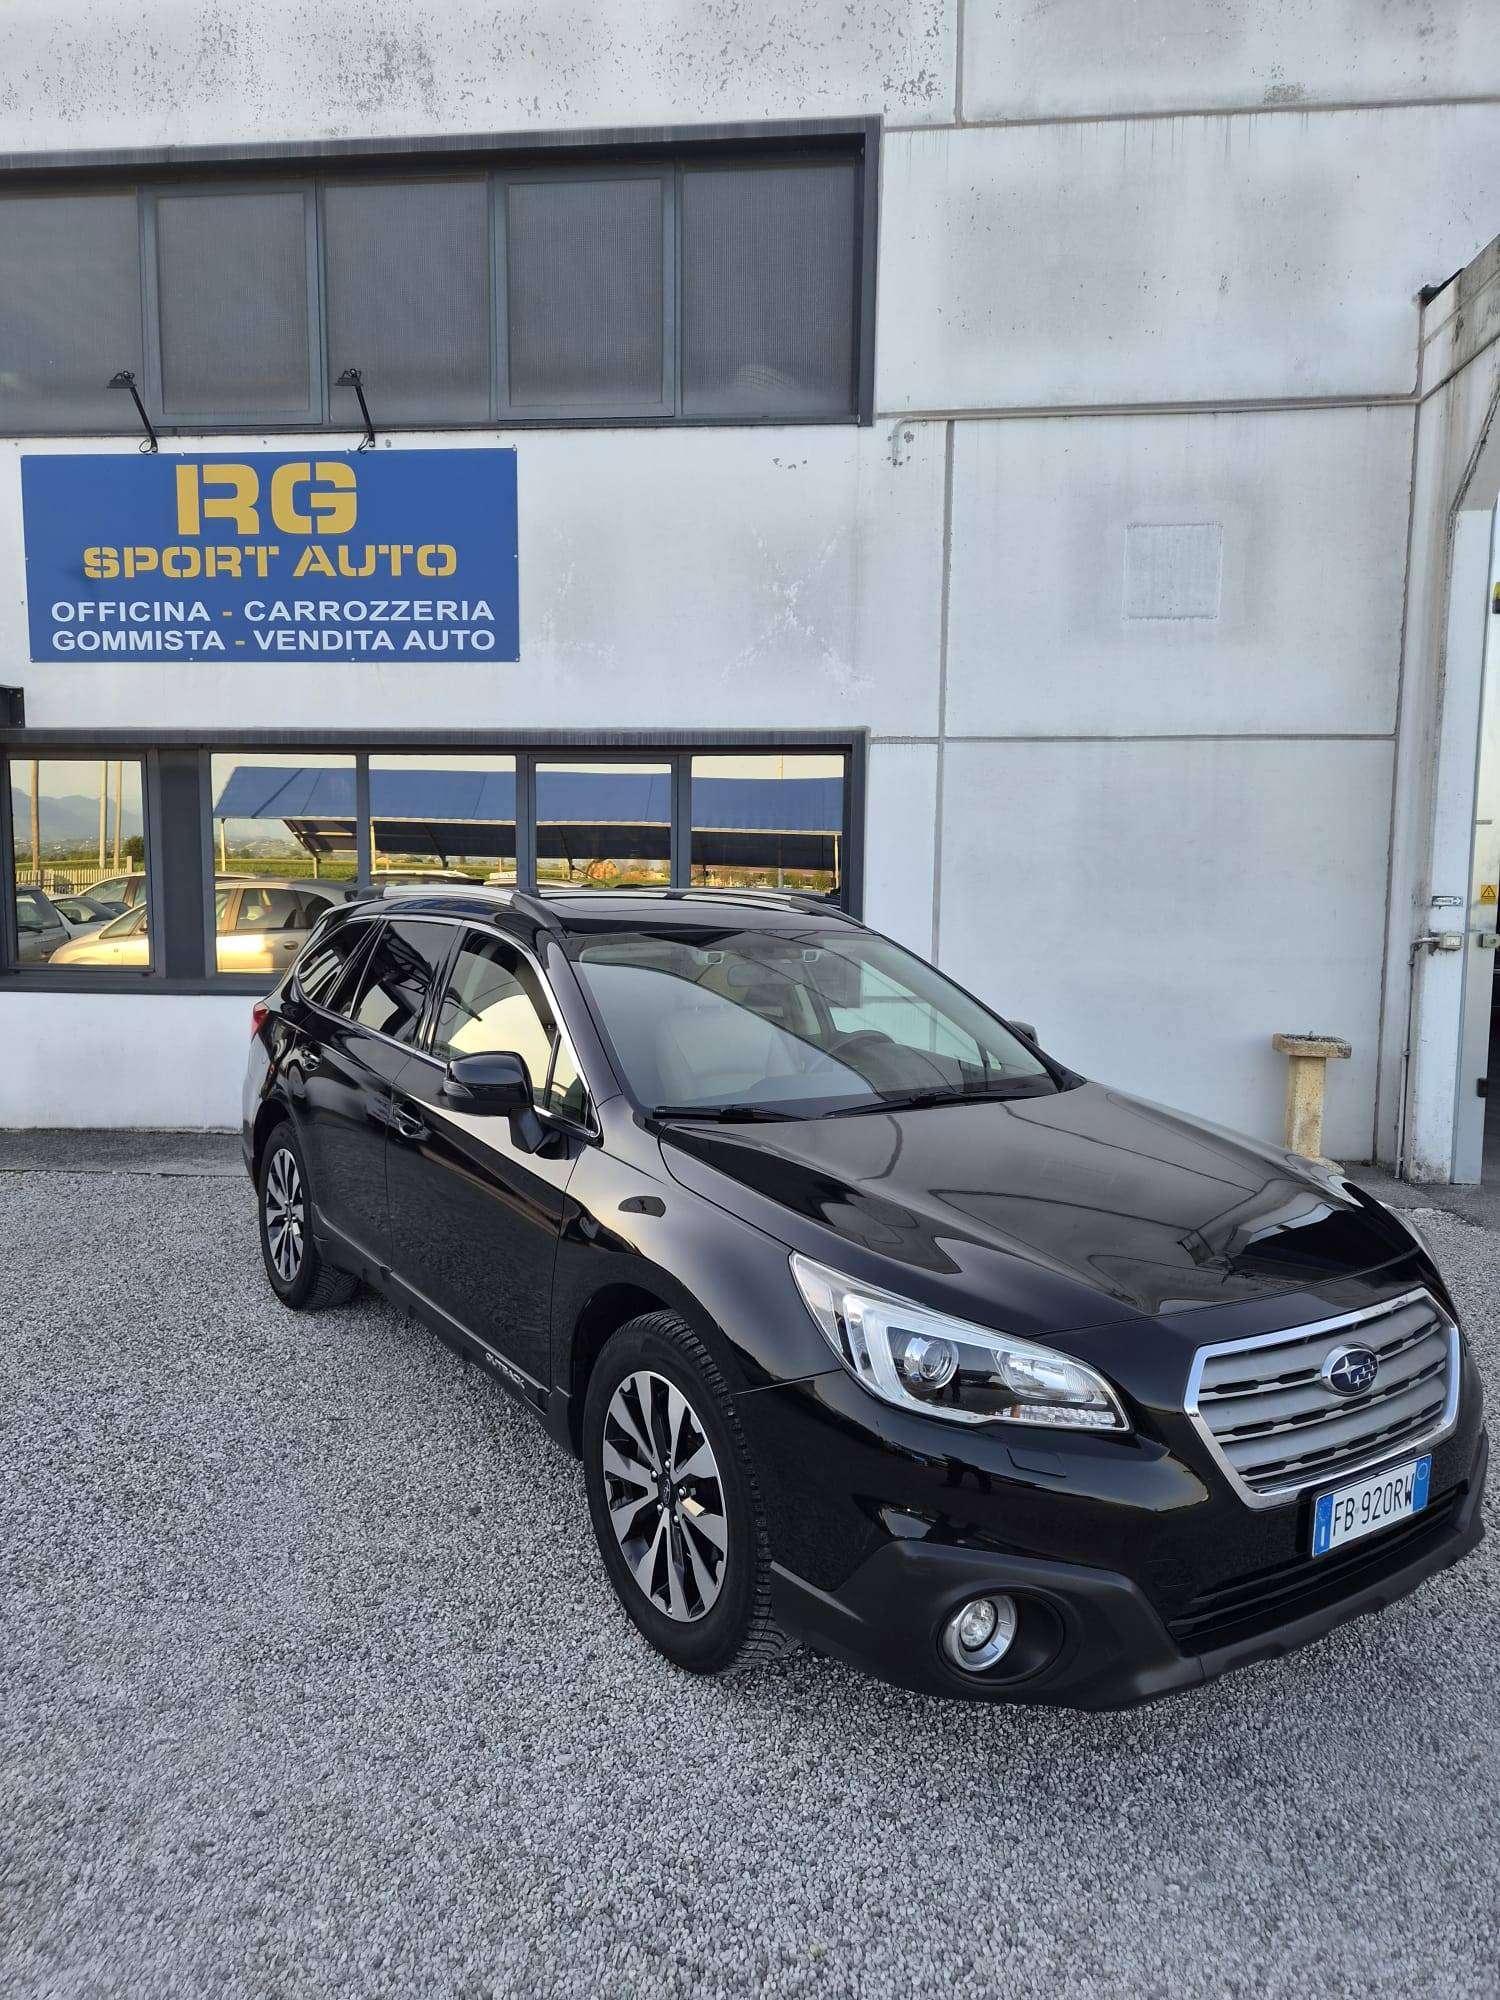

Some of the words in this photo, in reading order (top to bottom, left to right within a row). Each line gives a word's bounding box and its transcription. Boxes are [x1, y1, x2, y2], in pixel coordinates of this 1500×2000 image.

[175, 462, 358, 536] RG
[84, 547, 280, 579] SPORT
[293, 544, 458, 577] AUTO
[51, 602, 211, 623] OFFICINA
[244, 600, 495, 622] CARROZZERIA
[52, 631, 226, 651] GOMMISTA
[254, 630, 395, 651] VENDITA
[403, 630, 495, 651] AUTO
[1333, 1497, 1356, 1537] FB
[1361, 1472, 1416, 1525] 920RW
